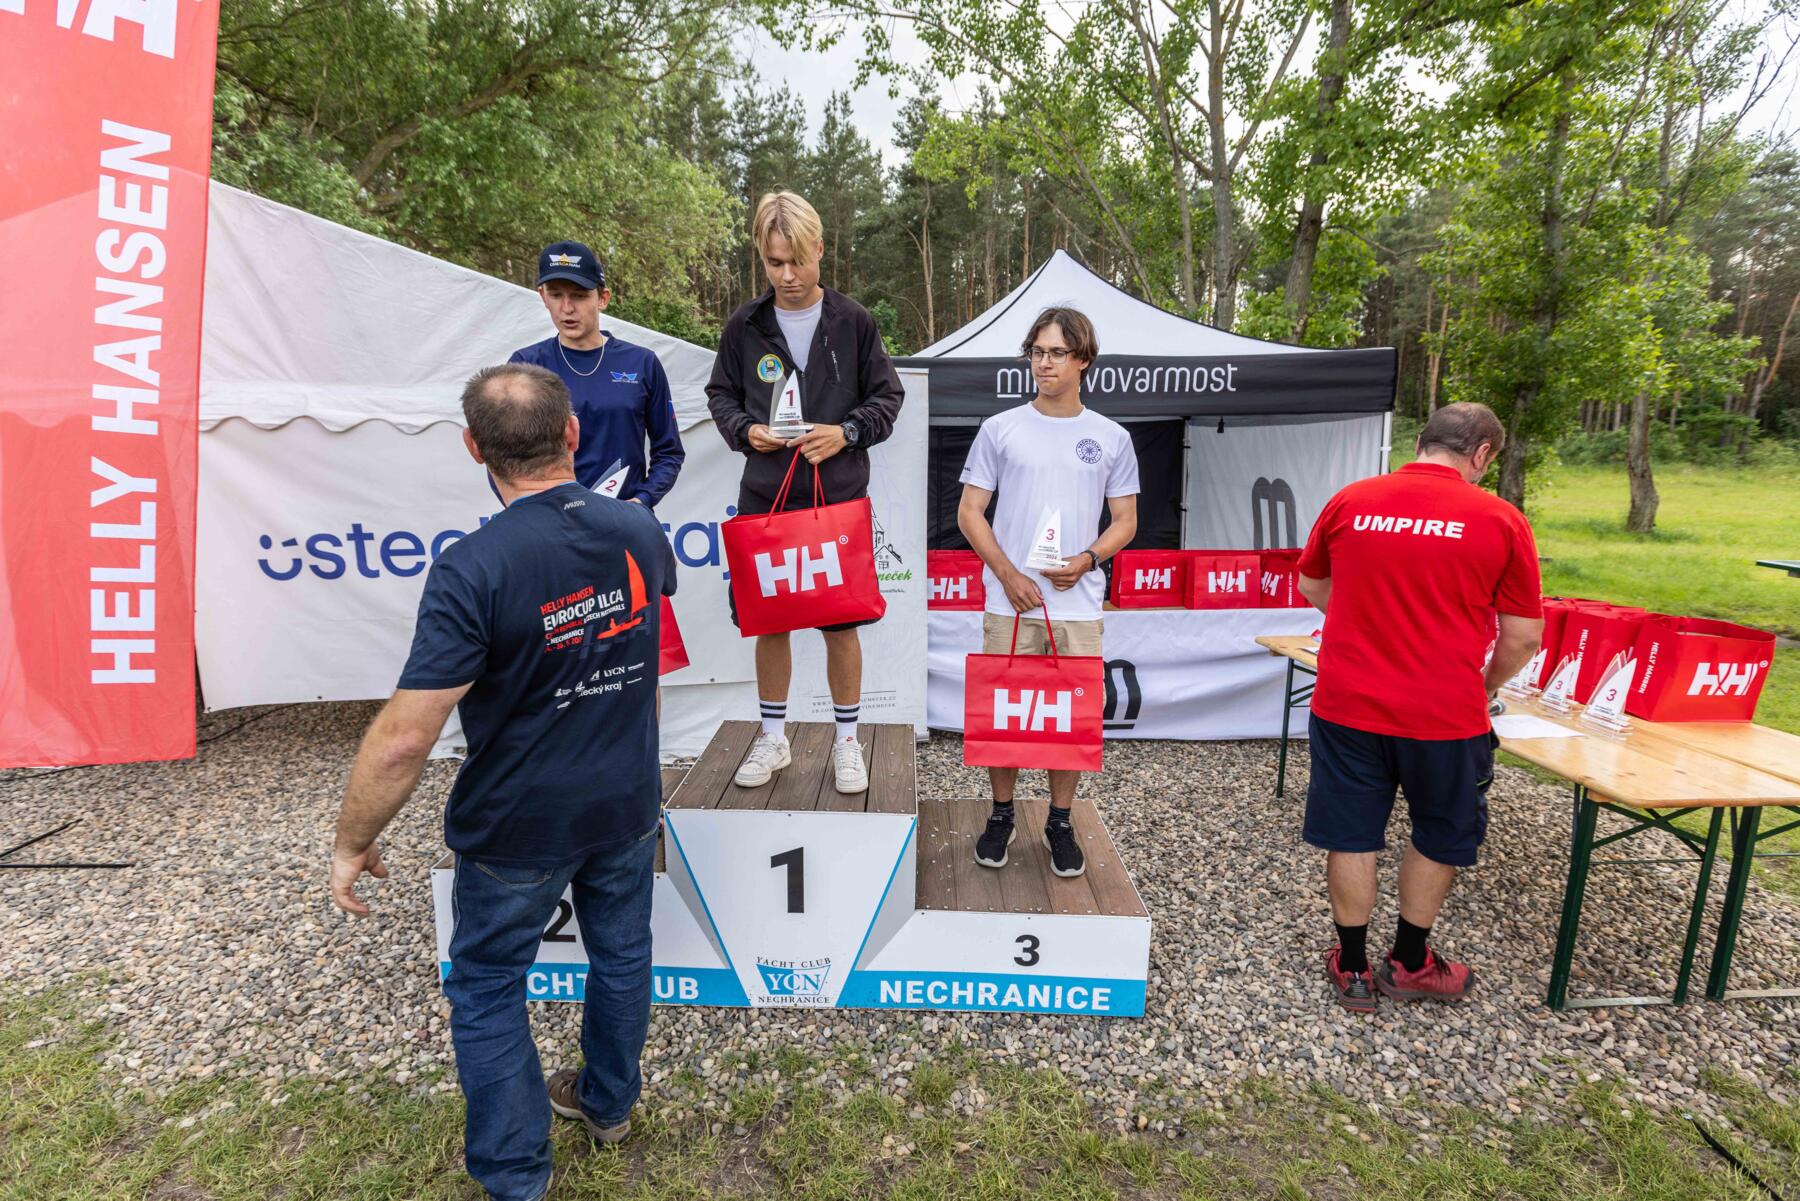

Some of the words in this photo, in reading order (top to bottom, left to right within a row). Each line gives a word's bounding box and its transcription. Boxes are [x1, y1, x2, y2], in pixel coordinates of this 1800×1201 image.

[91, 118, 172, 436] HANSEN
[786, 389, 794, 407] 1
[605, 480, 618, 492] 2
[1046, 528, 1055, 541] 3
[1353, 515, 1466, 539] UMPIRE
[90, 455, 157, 684] HELLY
[754, 541, 844, 598] HH
[1134, 568, 1171, 590] HH
[927, 577, 968, 600] HH
[1208, 570, 1246, 593] HH
[540, 597, 565, 615] HELLY
[565, 585, 594, 604] HANSEN
[597, 588, 624, 609] ILCA
[1649, 641, 1660, 665] HELLY
[604, 681, 622, 692] kraj
[1555, 681, 1564, 690] 3
[1638, 663, 1655, 694] HANSEN
[1686, 662, 1759, 696] HH
[1606, 689, 1617, 701] 3
[993, 688, 1072, 732] HH
[770, 846, 804, 914] 1
[543, 898, 577, 943] 2
[1014, 934, 1041, 967] 3
[756, 956, 796, 969] YACHT
[801, 957, 832, 969] CLUB
[767, 973, 821, 991] YCN
[758, 996, 831, 1004] NECHRANICE
[879, 979, 1112, 1012] NECHRANICE
